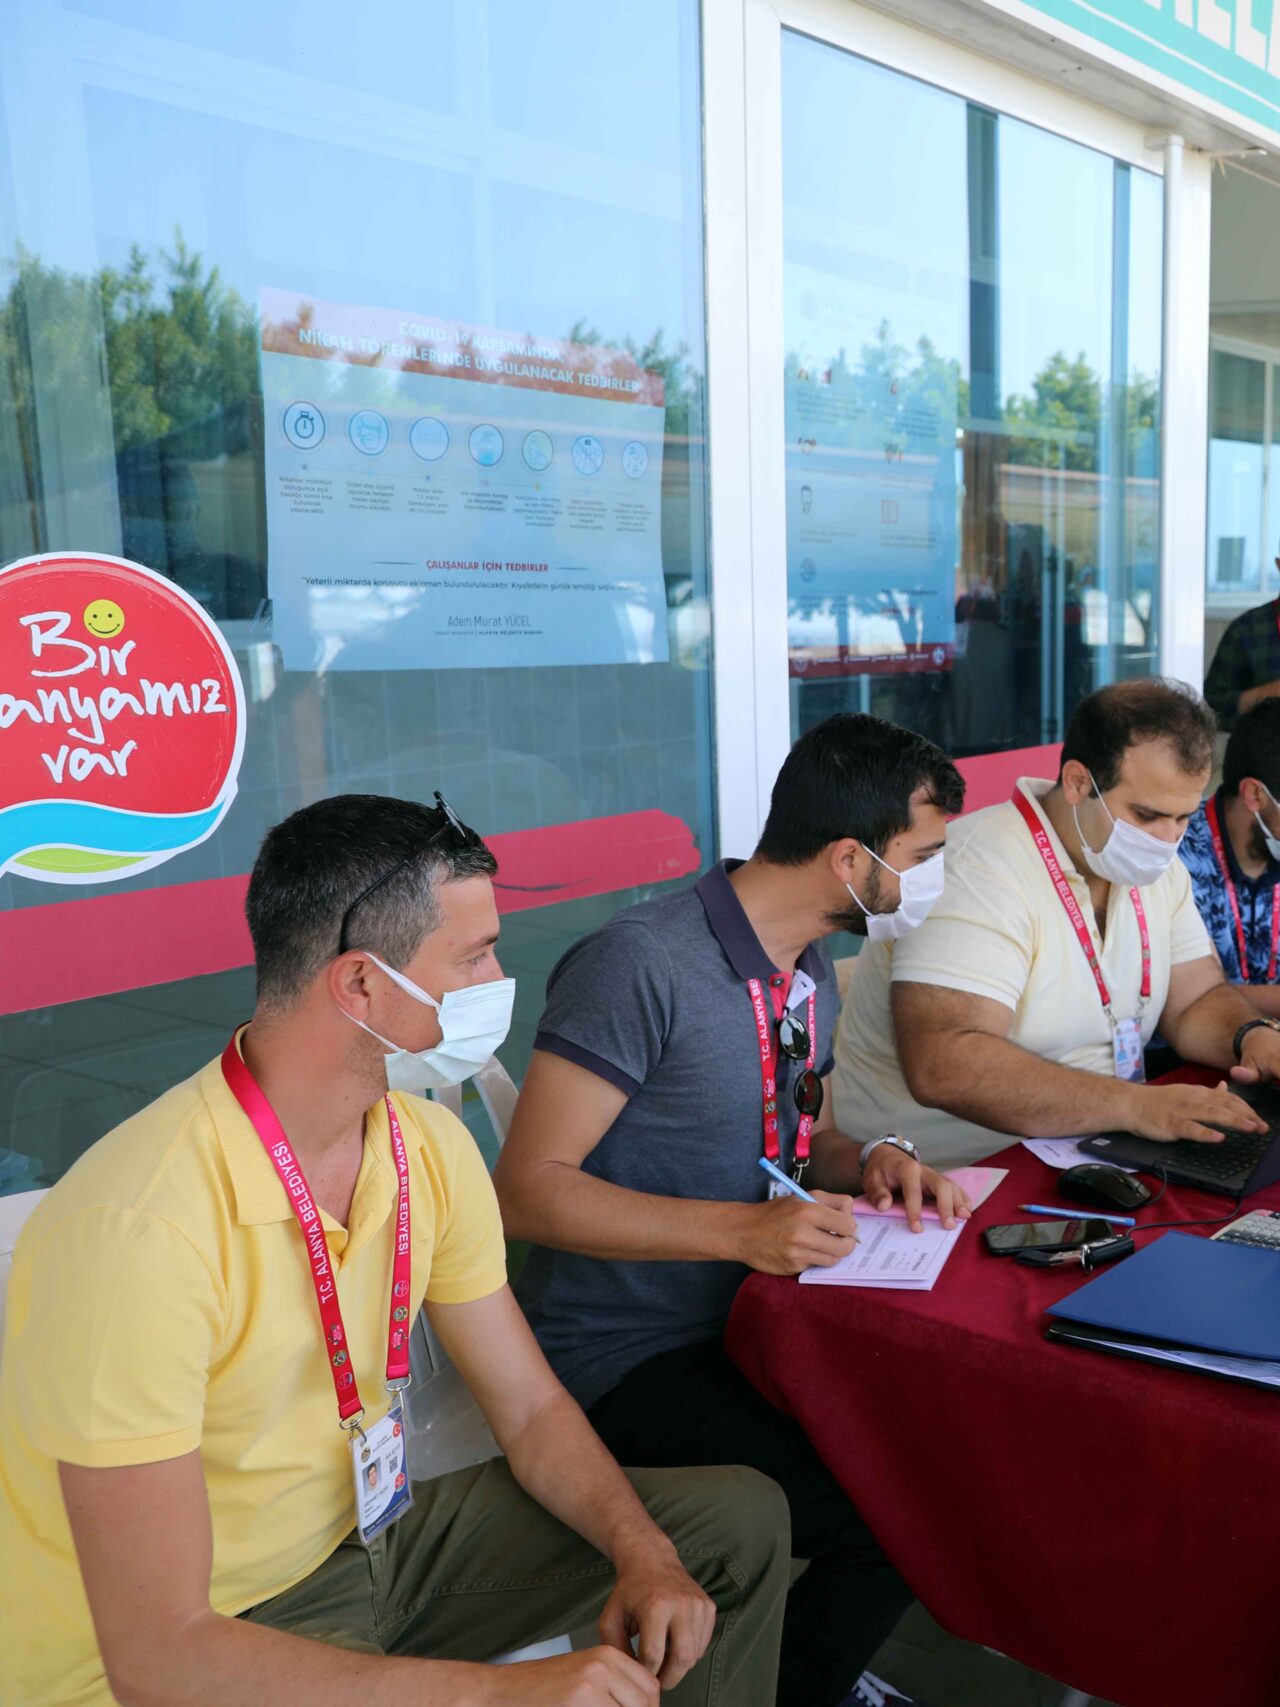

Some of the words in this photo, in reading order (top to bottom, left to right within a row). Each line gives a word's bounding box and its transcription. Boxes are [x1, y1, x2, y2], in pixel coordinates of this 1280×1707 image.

[400, 322, 469, 346] COVID-19
[475, 357, 575, 384] UYGULANACAK
[426, 560, 479, 571] ÇALIŞANLAR
[482, 561, 502, 572] İÇİN
[334, 577, 372, 587] miktarda
[447, 615, 472, 627] Adem
[474, 615, 502, 627] Murat
[504, 613, 531, 627] YÜCEL
[41, 739, 138, 784] var
[1041, 847, 1062, 882] ALANYA
[754, 998, 768, 1040] ALANYA
[760, 1040, 771, 1062] T.C.
[391, 1119, 407, 1174] ALANYA
[271, 1140, 316, 1223] BELEDİYESİ
[308, 1221, 329, 1277] ALANYA
[319, 1275, 334, 1304] T.C.
